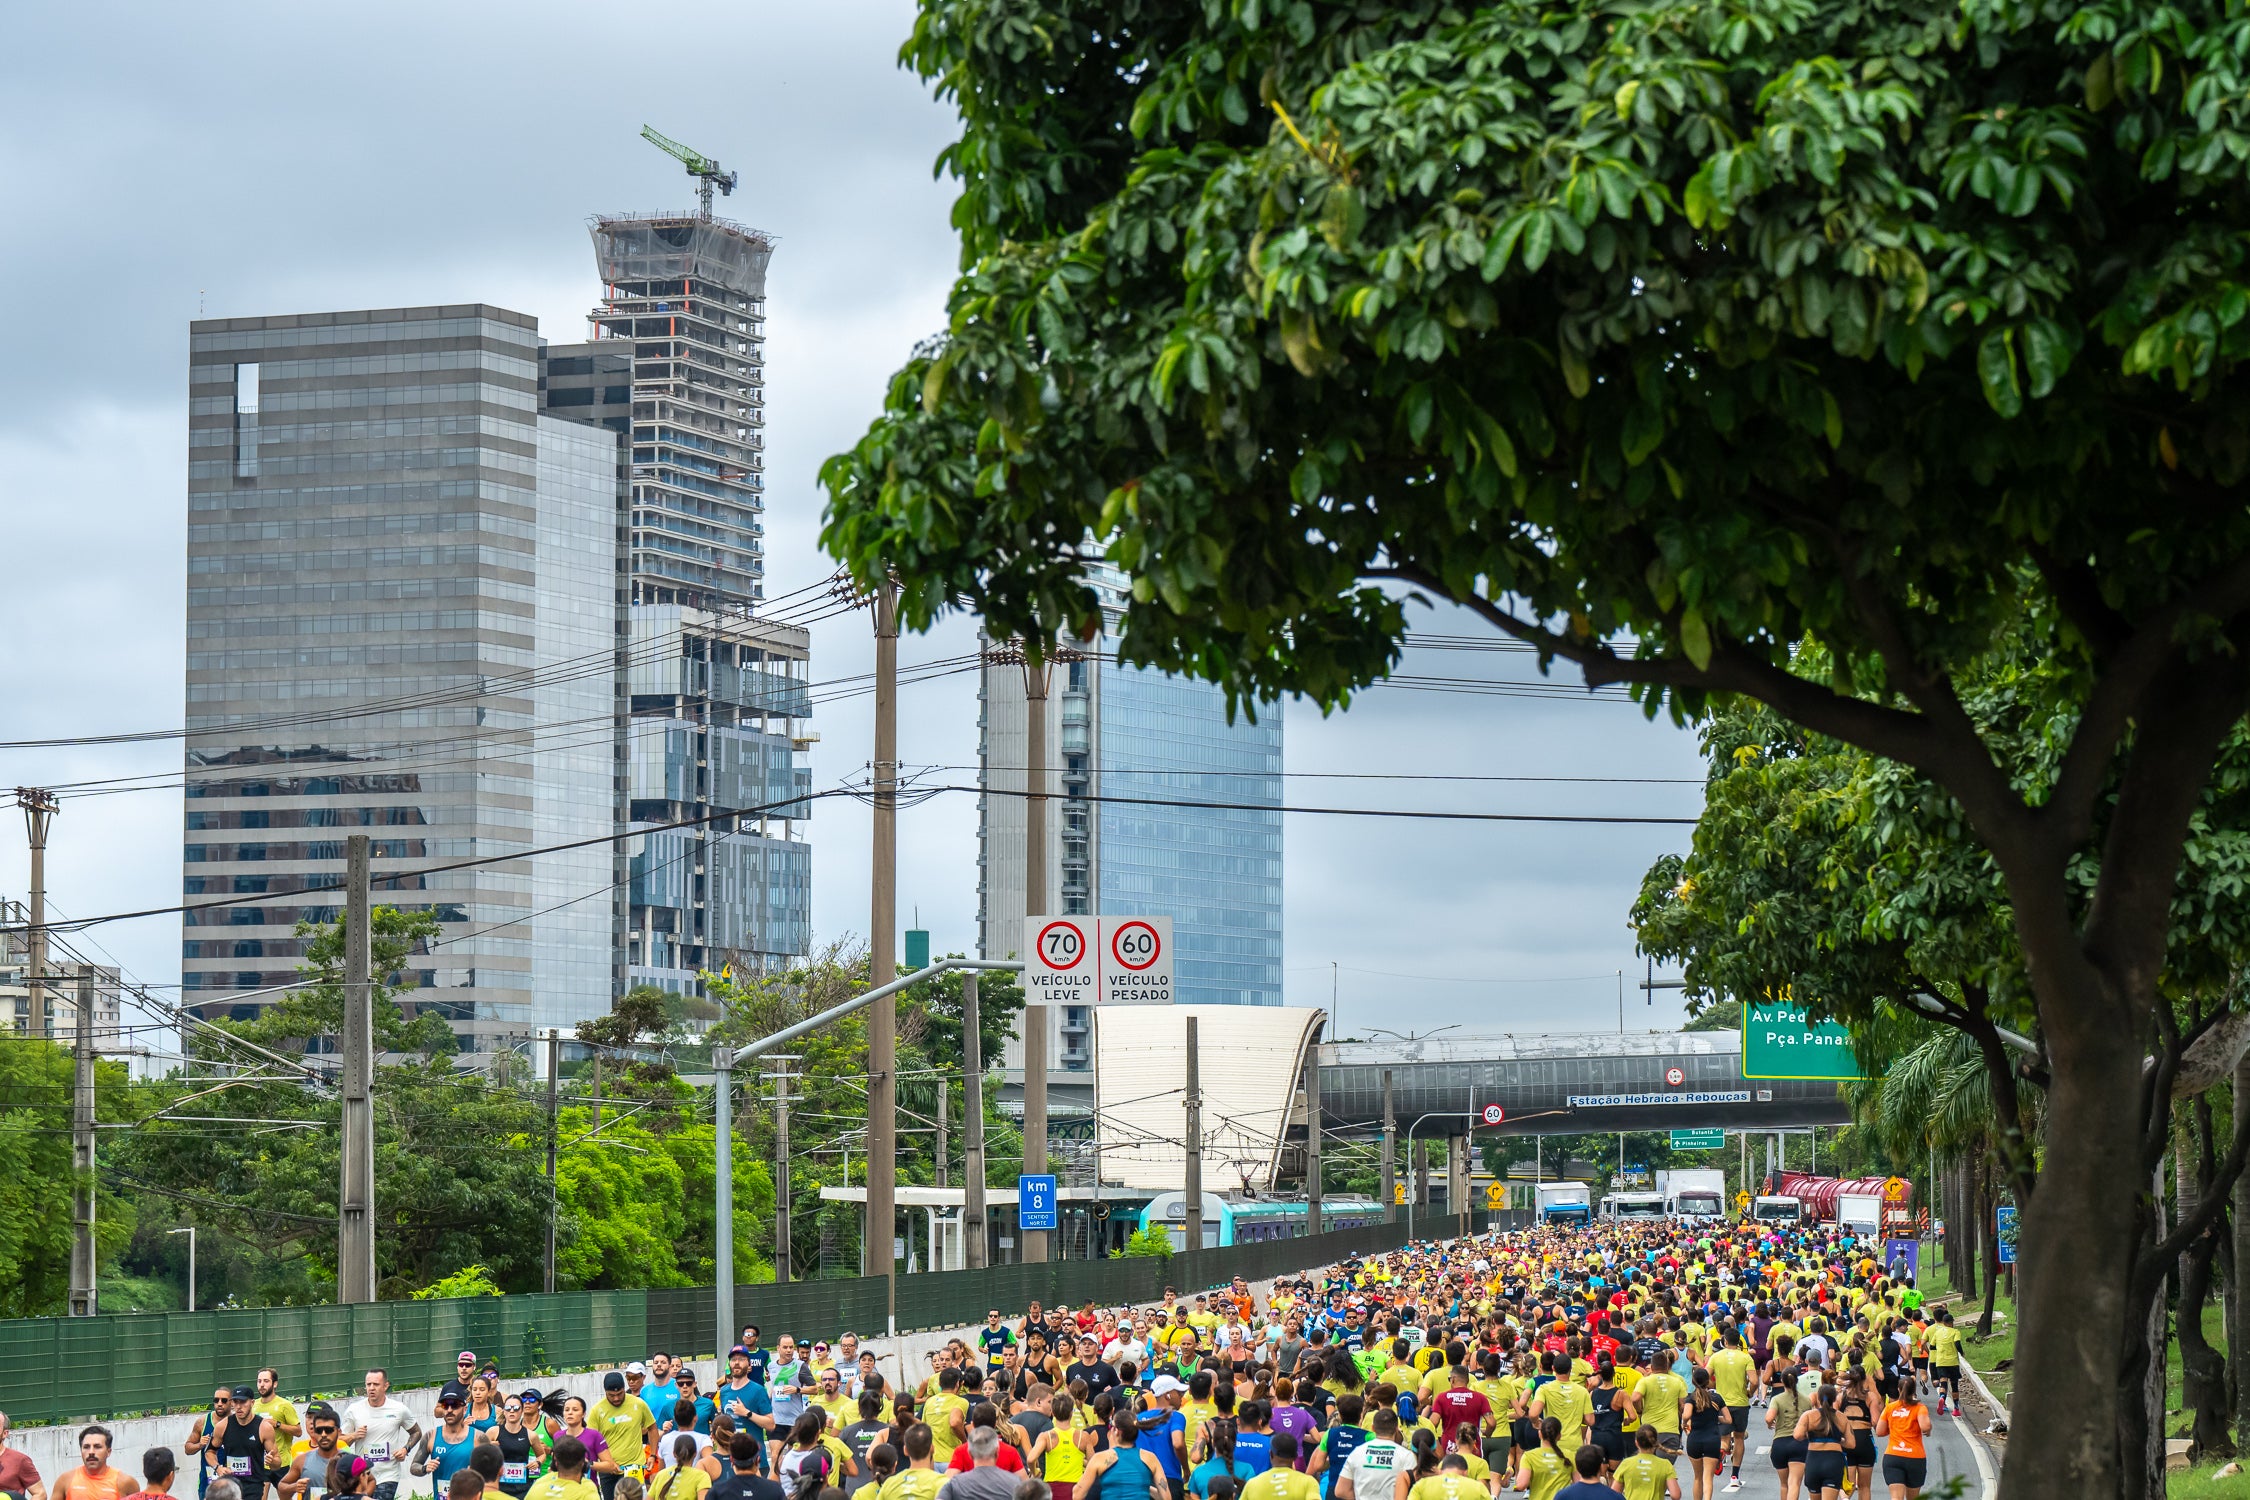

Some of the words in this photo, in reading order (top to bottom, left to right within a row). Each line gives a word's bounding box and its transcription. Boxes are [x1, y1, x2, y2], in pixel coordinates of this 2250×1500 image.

[1047, 934, 1077, 954] 70
[1122, 934, 1152, 954] 60
[1031, 973, 1091, 986] VEÍCULO
[1109, 973, 1169, 986] VEÍCULO
[1044, 990, 1080, 1000] LEVE
[1111, 990, 1169, 1000] PESADO
[1752, 1010, 1773, 1022] Av.
[1766, 1032, 1799, 1047] Pça.
[1570, 1096, 1620, 1106] Estação
[1486, 1109, 1500, 1118] 60
[1027, 1181, 1047, 1191] km
[1033, 1195, 1042, 1208] 8
[1376, 1456, 1393, 1465] 15K
